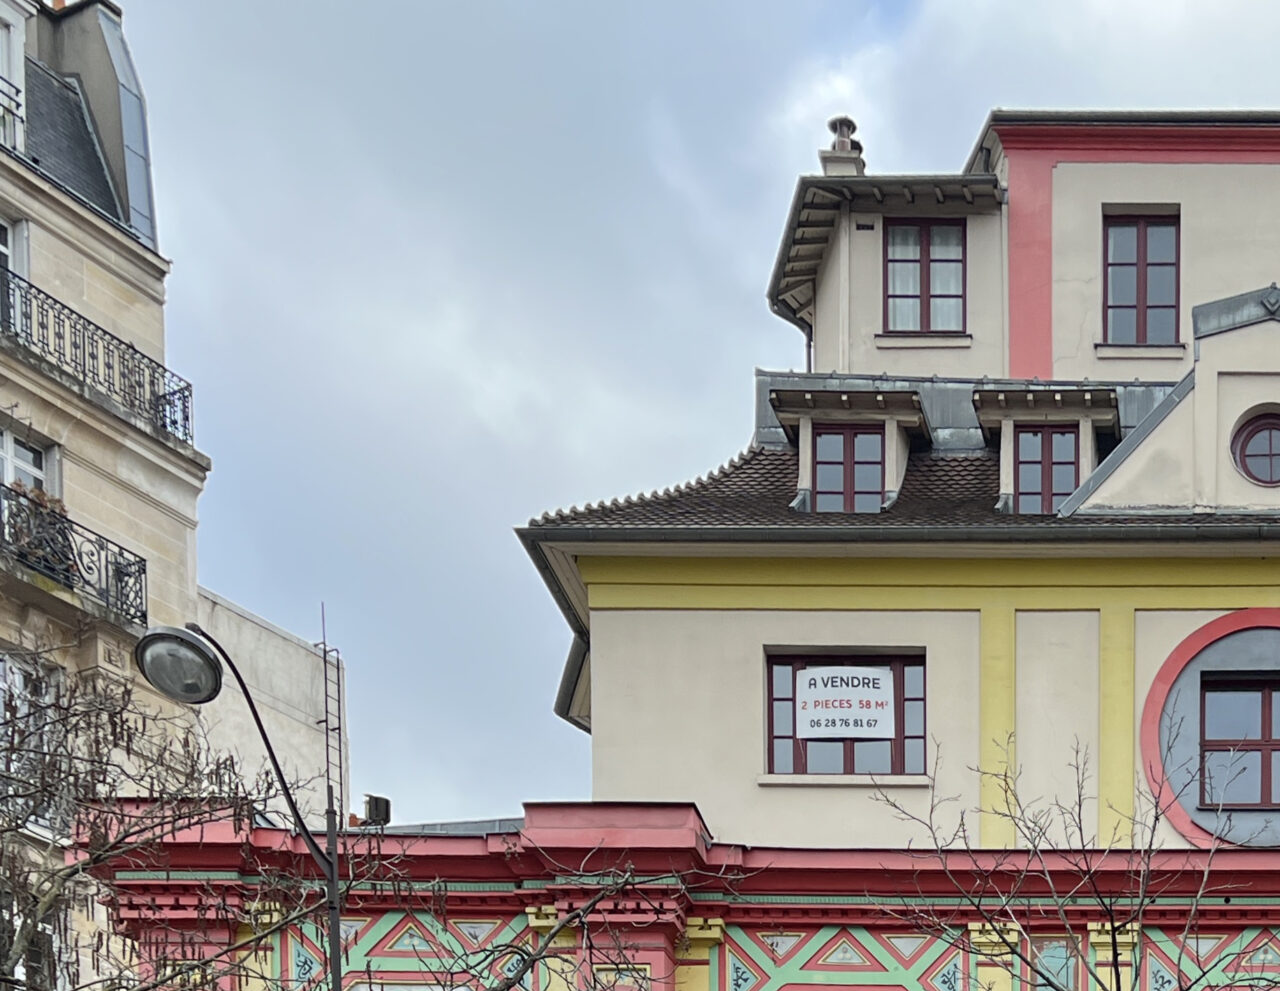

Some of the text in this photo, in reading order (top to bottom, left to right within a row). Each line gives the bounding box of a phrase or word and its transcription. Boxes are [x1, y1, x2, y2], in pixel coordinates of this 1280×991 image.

[808, 676, 881, 690] A VENDRE
[801, 701, 808, 710] 2
[814, 699, 852, 709] PIECES
[859, 700, 872, 709] 58
[810, 718, 878, 728] 06 28 76 81 67
